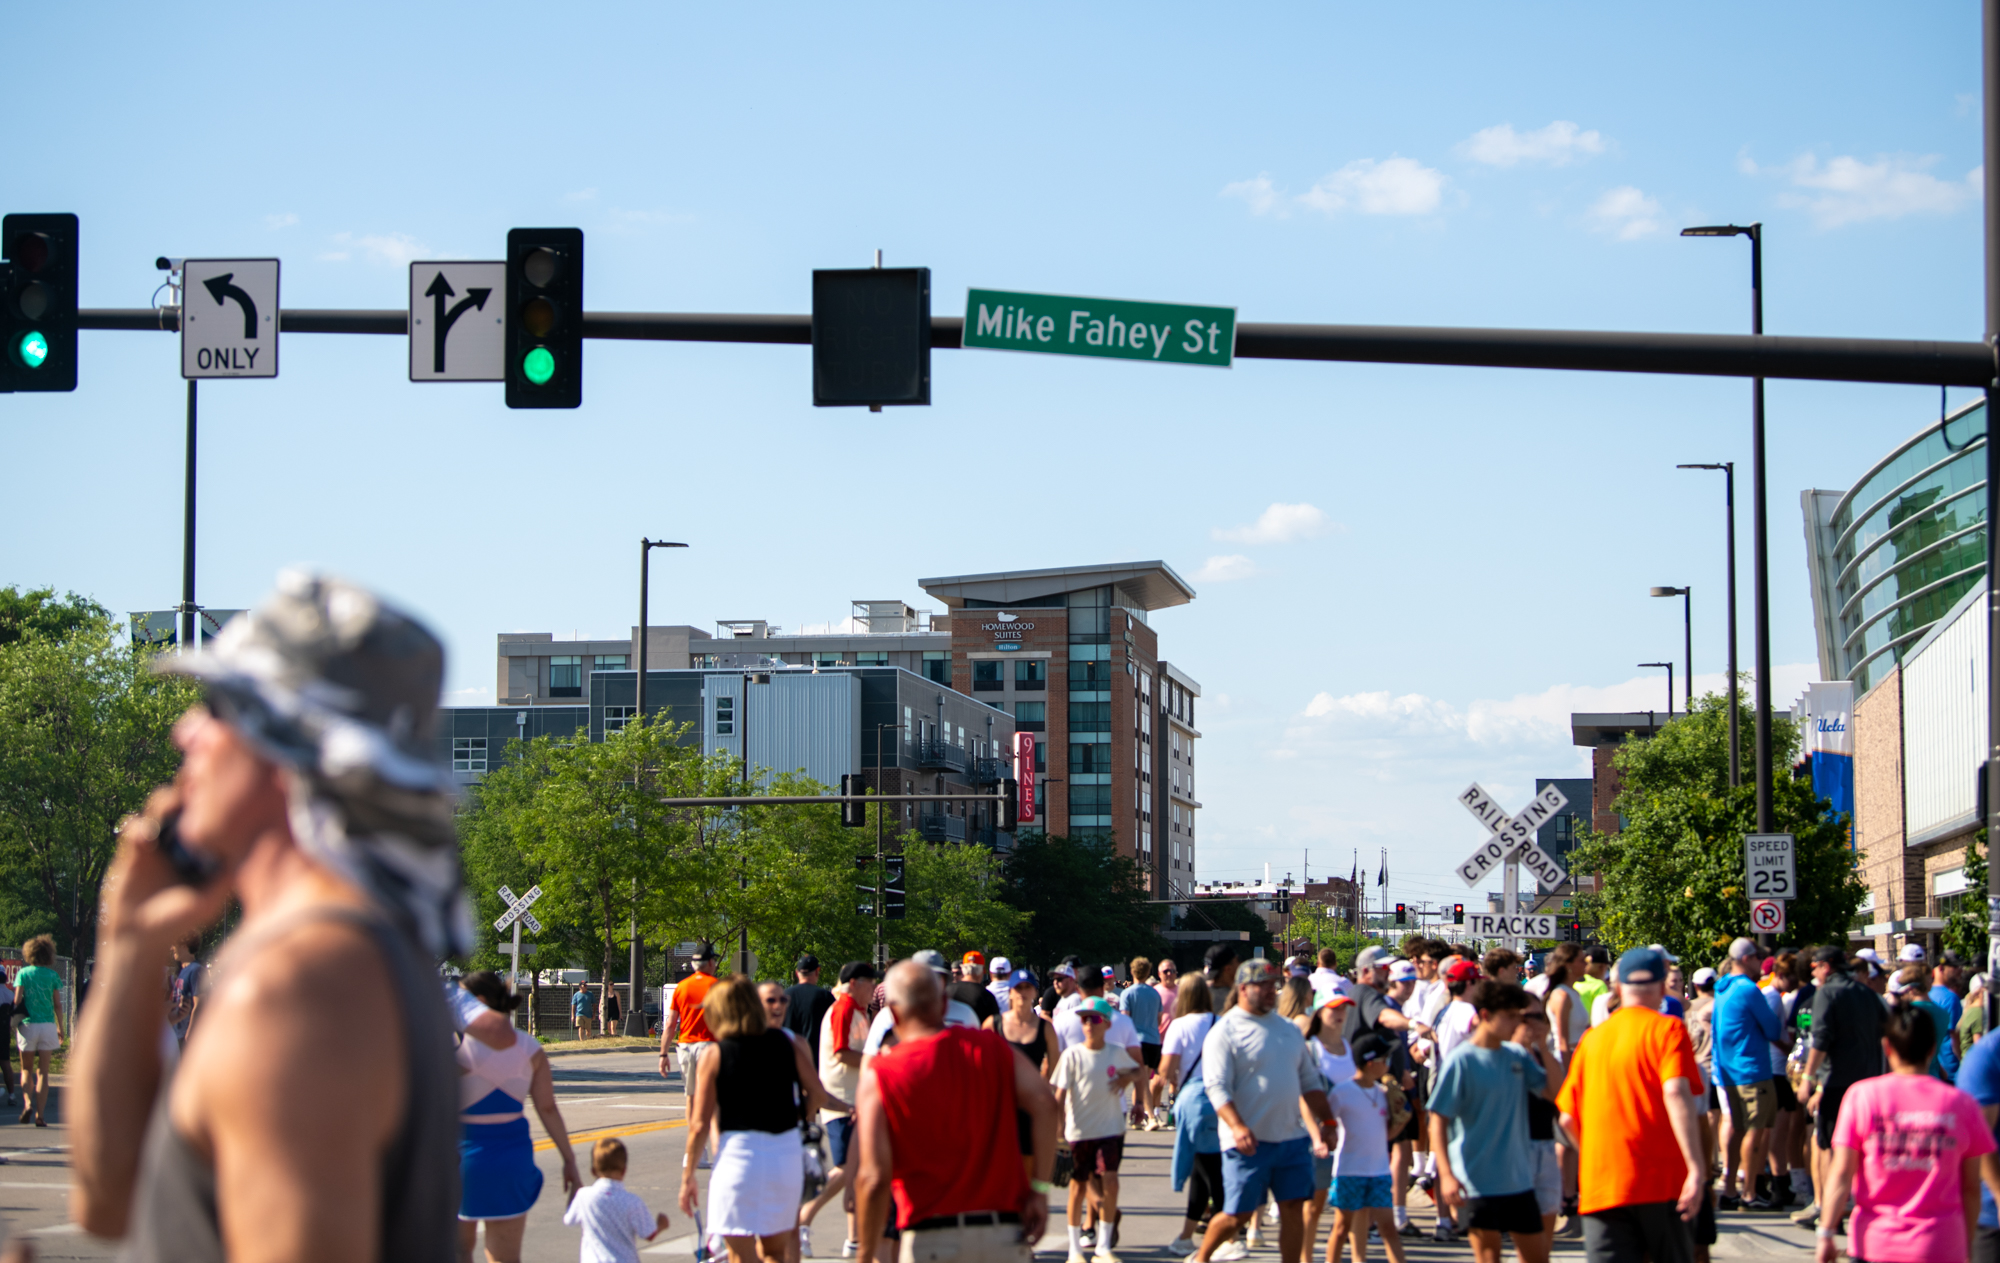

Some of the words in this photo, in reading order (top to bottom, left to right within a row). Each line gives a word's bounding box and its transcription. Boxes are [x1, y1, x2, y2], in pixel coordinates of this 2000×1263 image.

[976, 303, 1055, 342] Mike
[1068, 310, 1172, 359] Fahey
[1182, 319, 1222, 355] St
[197, 347, 260, 370] ONLY
[981, 622, 1035, 631] HOMEWOOD
[994, 631, 1022, 639] SUITES
[1023, 737, 1034, 818] 9INES
[1463, 792, 1560, 881] CROSSING
[1750, 841, 1789, 852] SPEED
[1754, 855, 1785, 866] LIMIT
[1753, 870, 1788, 893] 25
[496, 887, 541, 930] CROSSING
[1470, 915, 1550, 935] TRACKS
